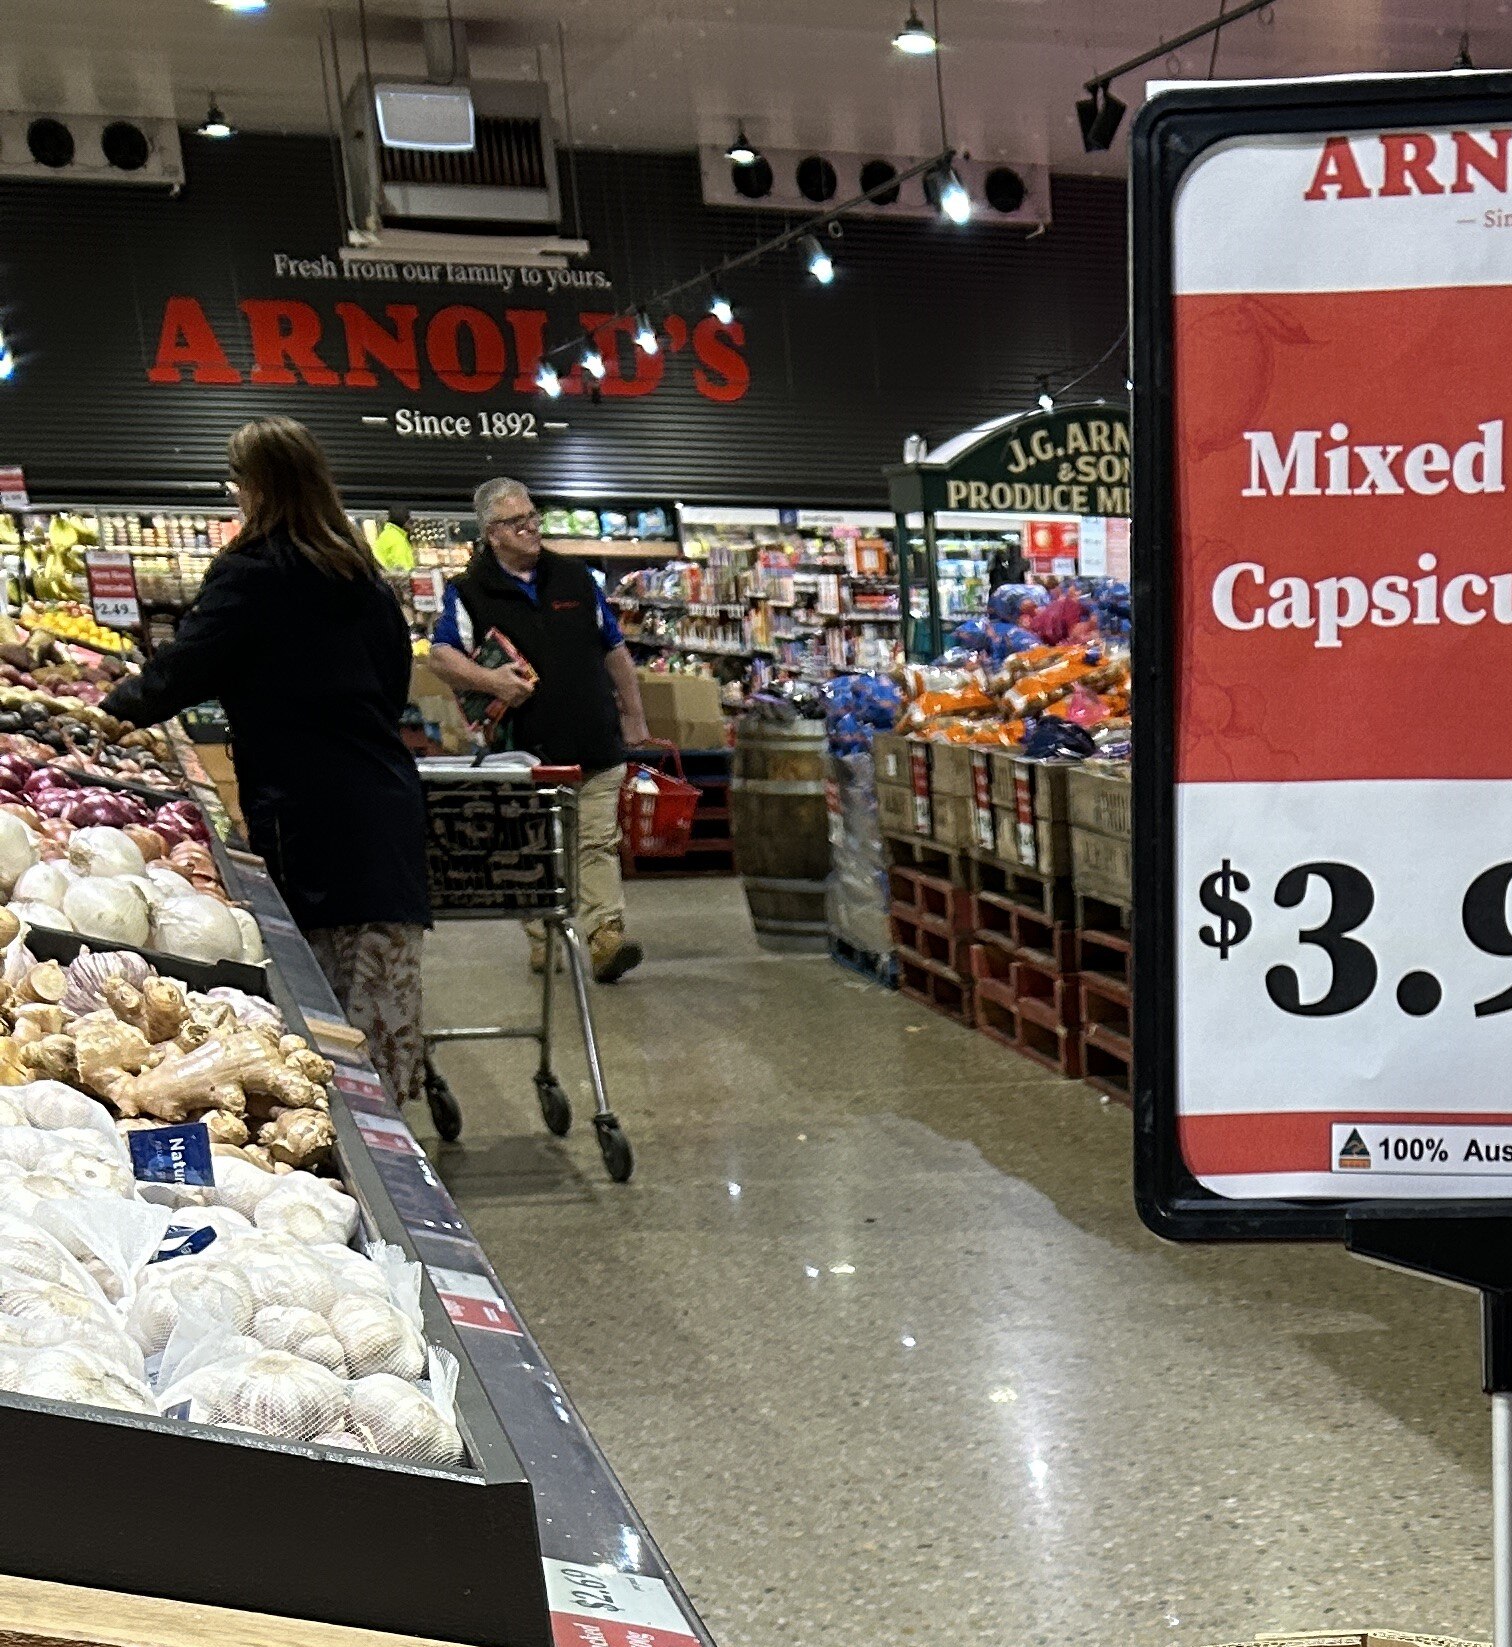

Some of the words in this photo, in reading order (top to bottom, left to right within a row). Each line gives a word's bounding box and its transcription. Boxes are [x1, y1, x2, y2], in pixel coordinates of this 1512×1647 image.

[274, 253, 338, 280] Fresh
[343, 260, 398, 280] from
[402, 263, 442, 282] our
[446, 262, 515, 290] family
[521, 265, 544, 287] to
[548, 268, 612, 291] yours.
[146, 296, 750, 403] ARNOLD'S
[395, 408, 472, 437] Since
[476, 411, 538, 438] 1892
[1242, 418, 1505, 499] Mixed
[947, 480, 1090, 513] PRODUCE
[1378, 1138, 1449, 1164] 100%
[560, 1568, 626, 1612] $2.69
